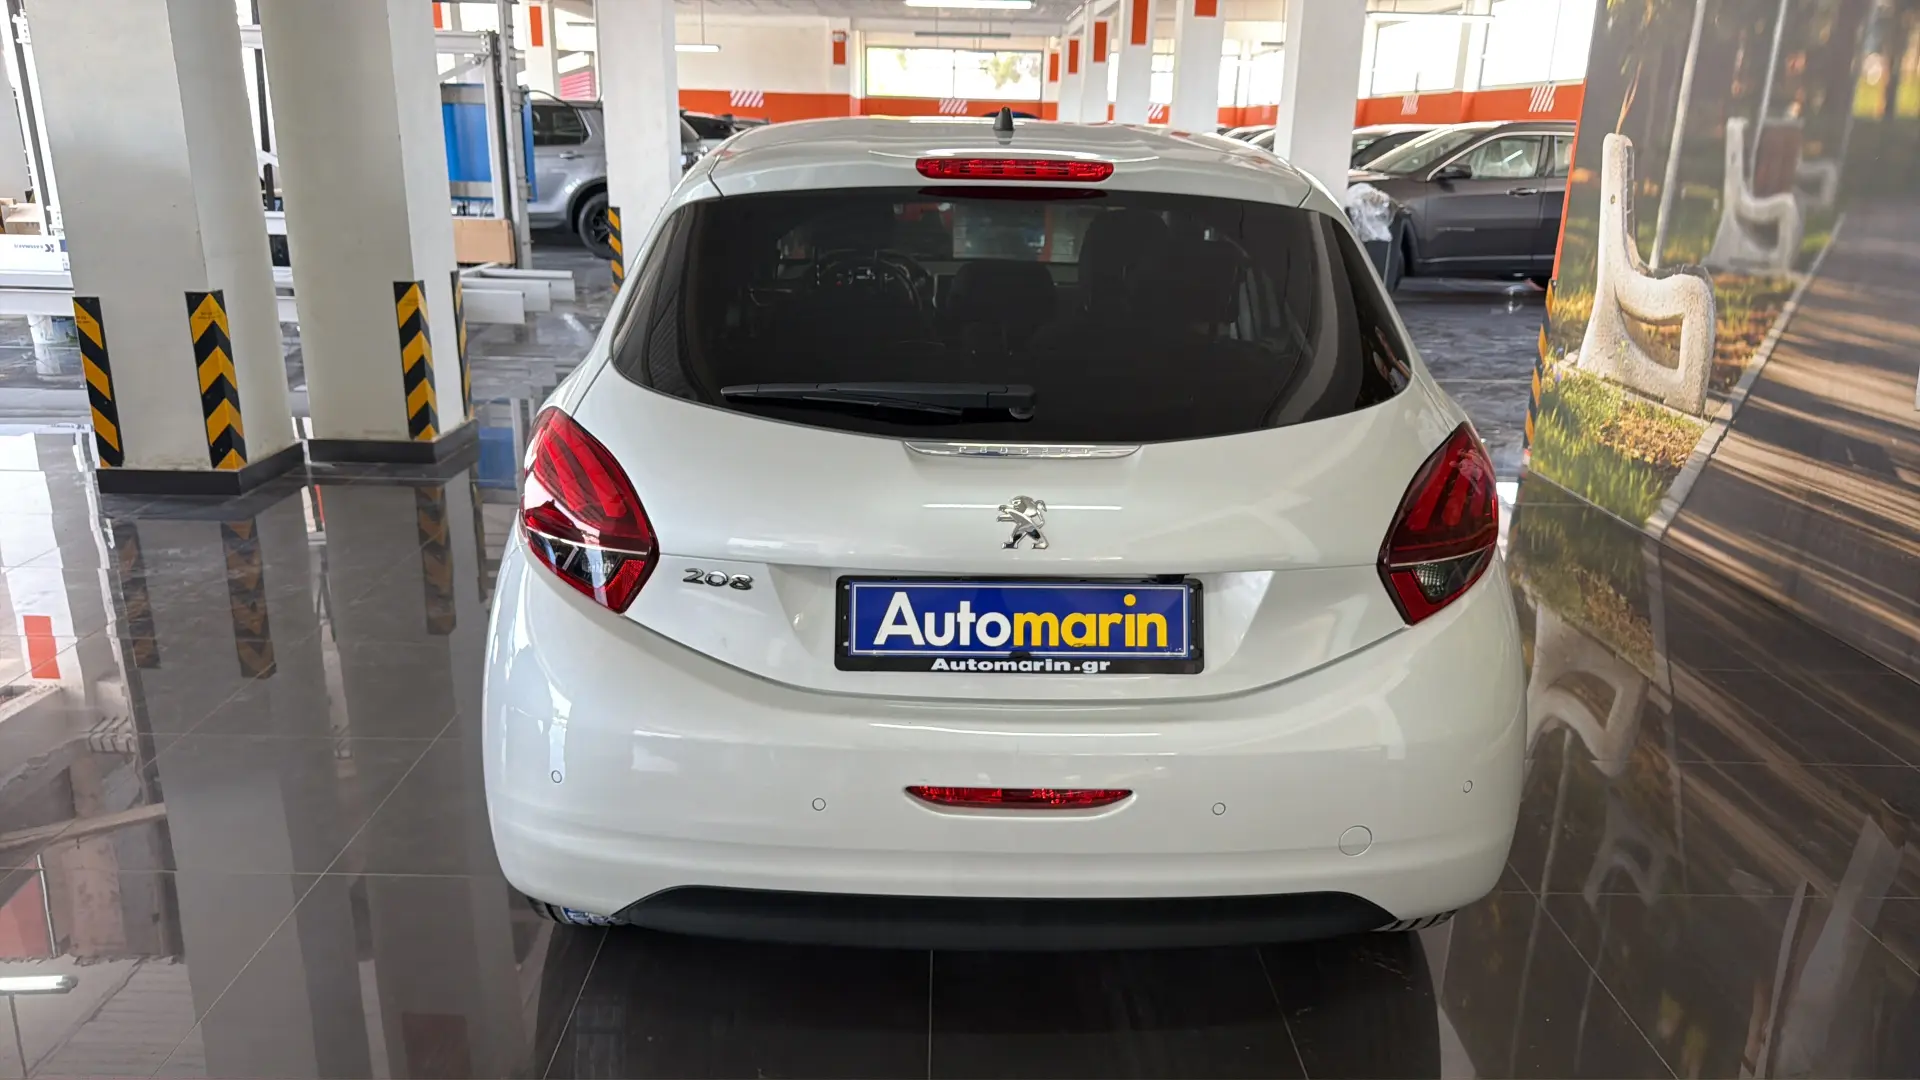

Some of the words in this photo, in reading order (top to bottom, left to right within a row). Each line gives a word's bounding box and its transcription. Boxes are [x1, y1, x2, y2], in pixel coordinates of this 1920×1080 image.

[682, 567, 753, 590] 208
[873, 591, 1168, 648] Automarin
[930, 658, 1111, 674] Automarin.gr
